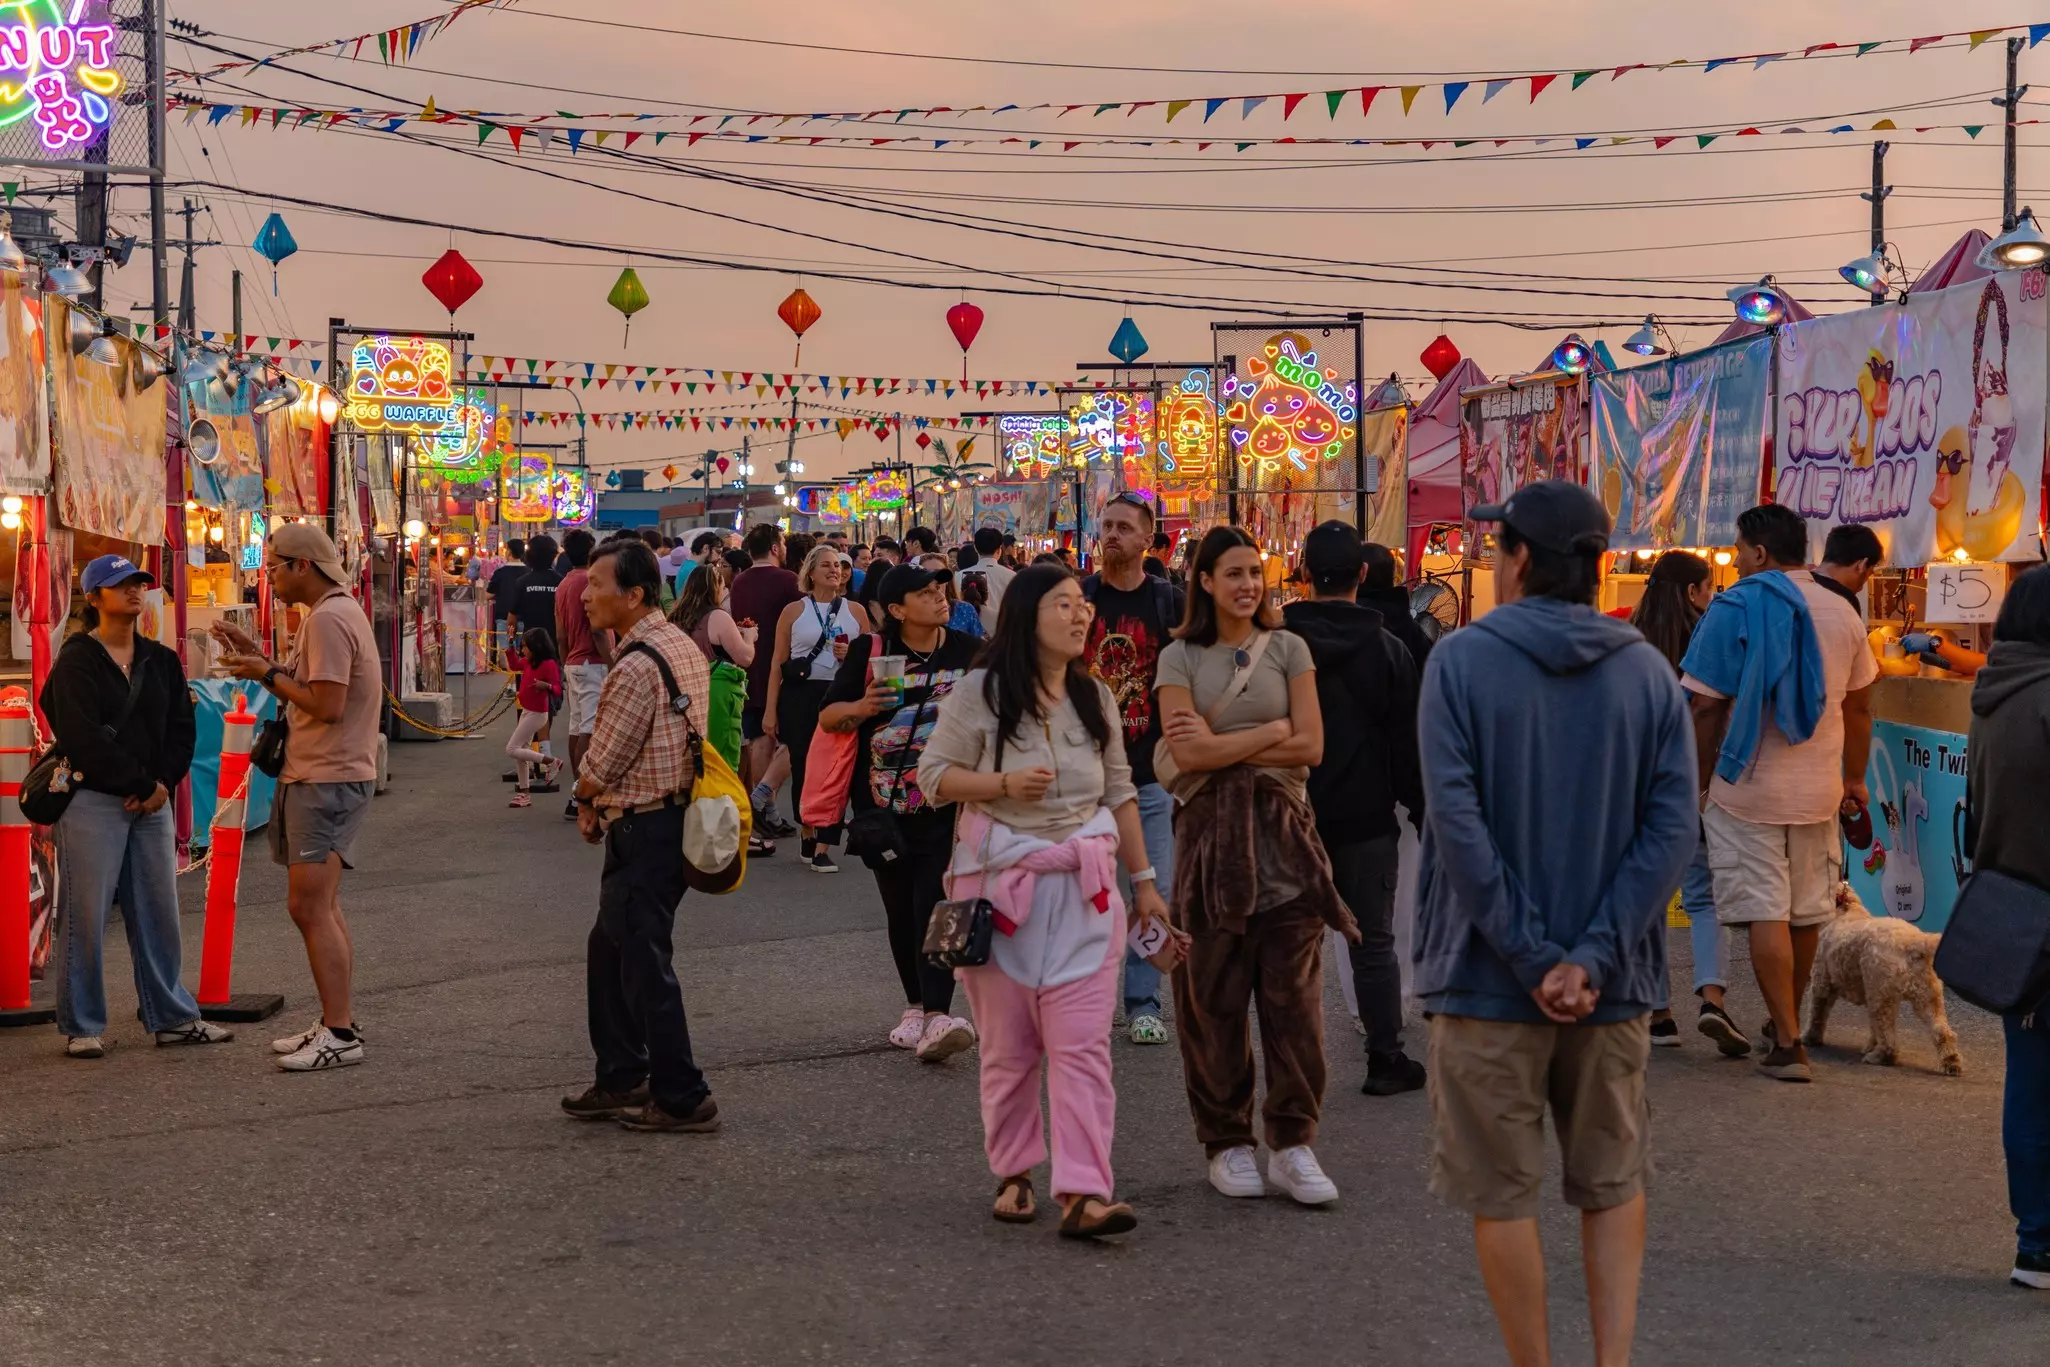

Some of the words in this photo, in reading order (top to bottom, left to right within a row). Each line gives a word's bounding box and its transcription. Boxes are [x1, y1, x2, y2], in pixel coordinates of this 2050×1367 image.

[341, 403, 381, 419] EGG
[384, 405, 456, 422] WAFFLE
[1940, 568, 1991, 609] $5
[1904, 738, 1931, 769] The
[1937, 745, 1968, 777] Twi
